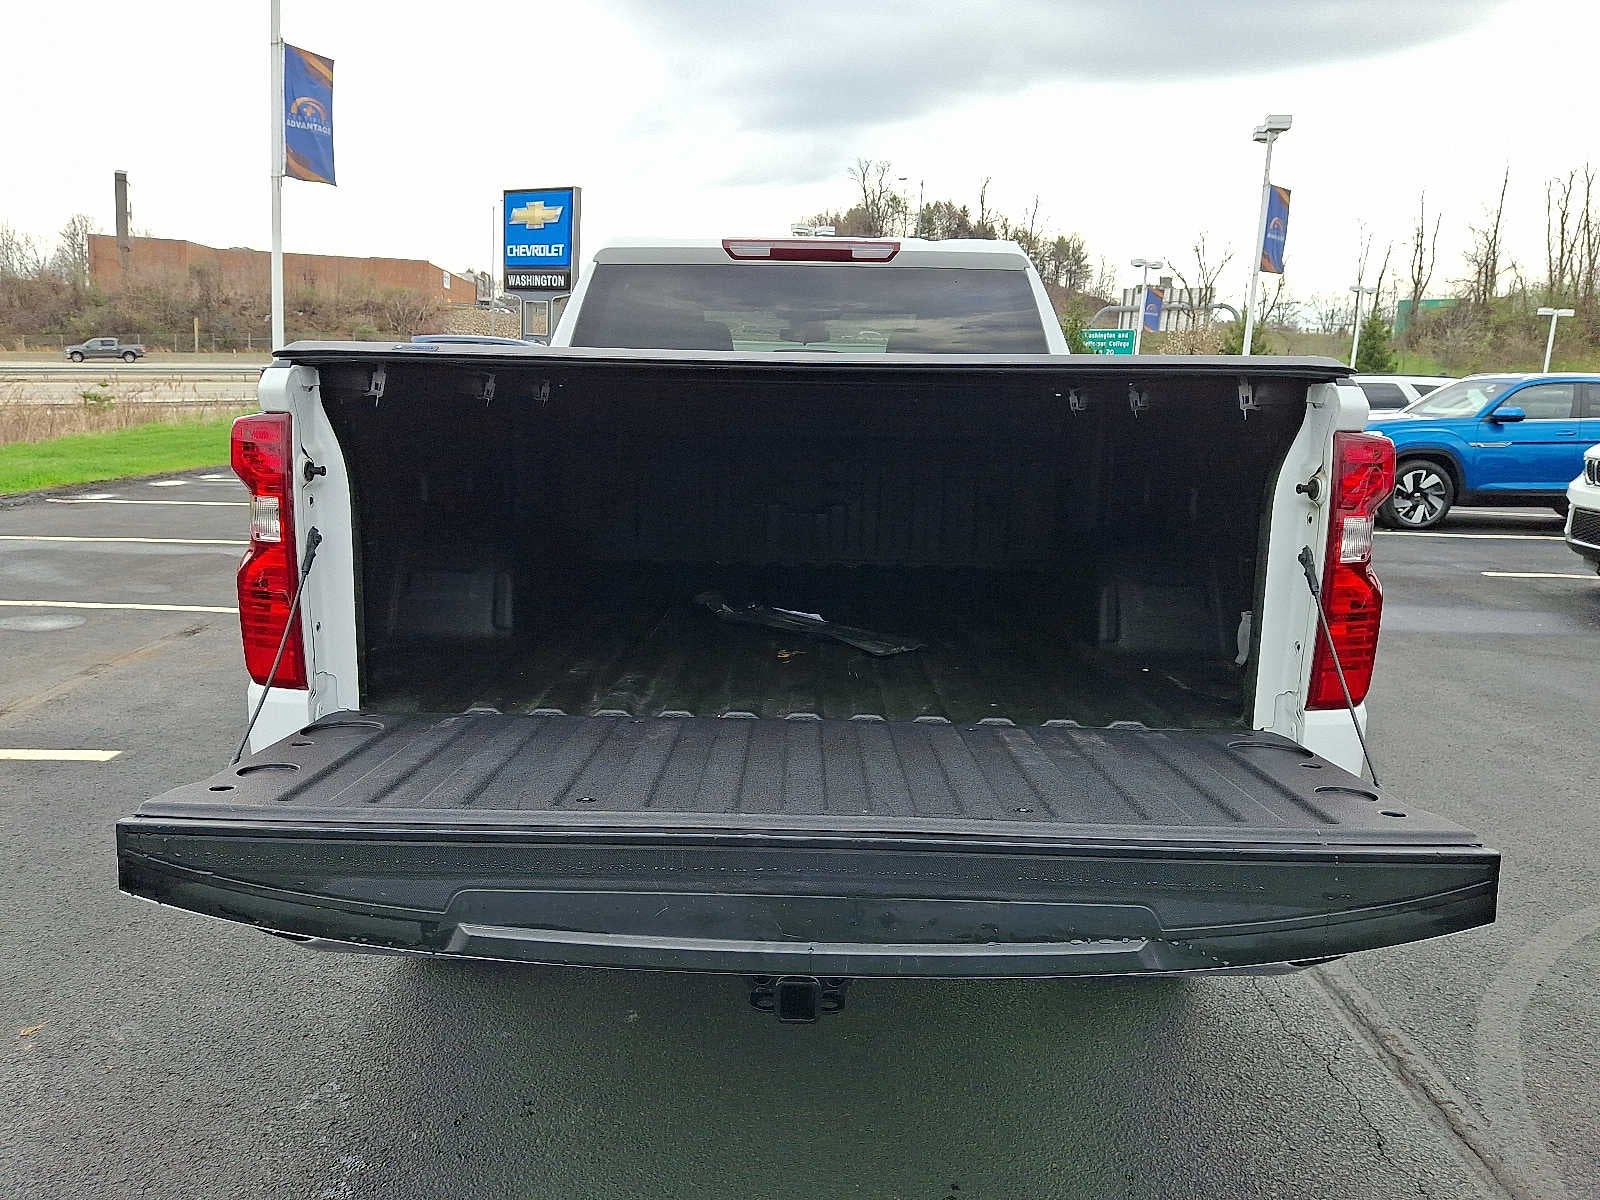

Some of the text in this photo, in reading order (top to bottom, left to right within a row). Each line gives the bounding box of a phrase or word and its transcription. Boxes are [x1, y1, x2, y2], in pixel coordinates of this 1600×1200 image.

[507, 244, 565, 257] CHEVROLET
[507, 274, 565, 287] WASHINGTON
[1108, 341, 1130, 349] College
